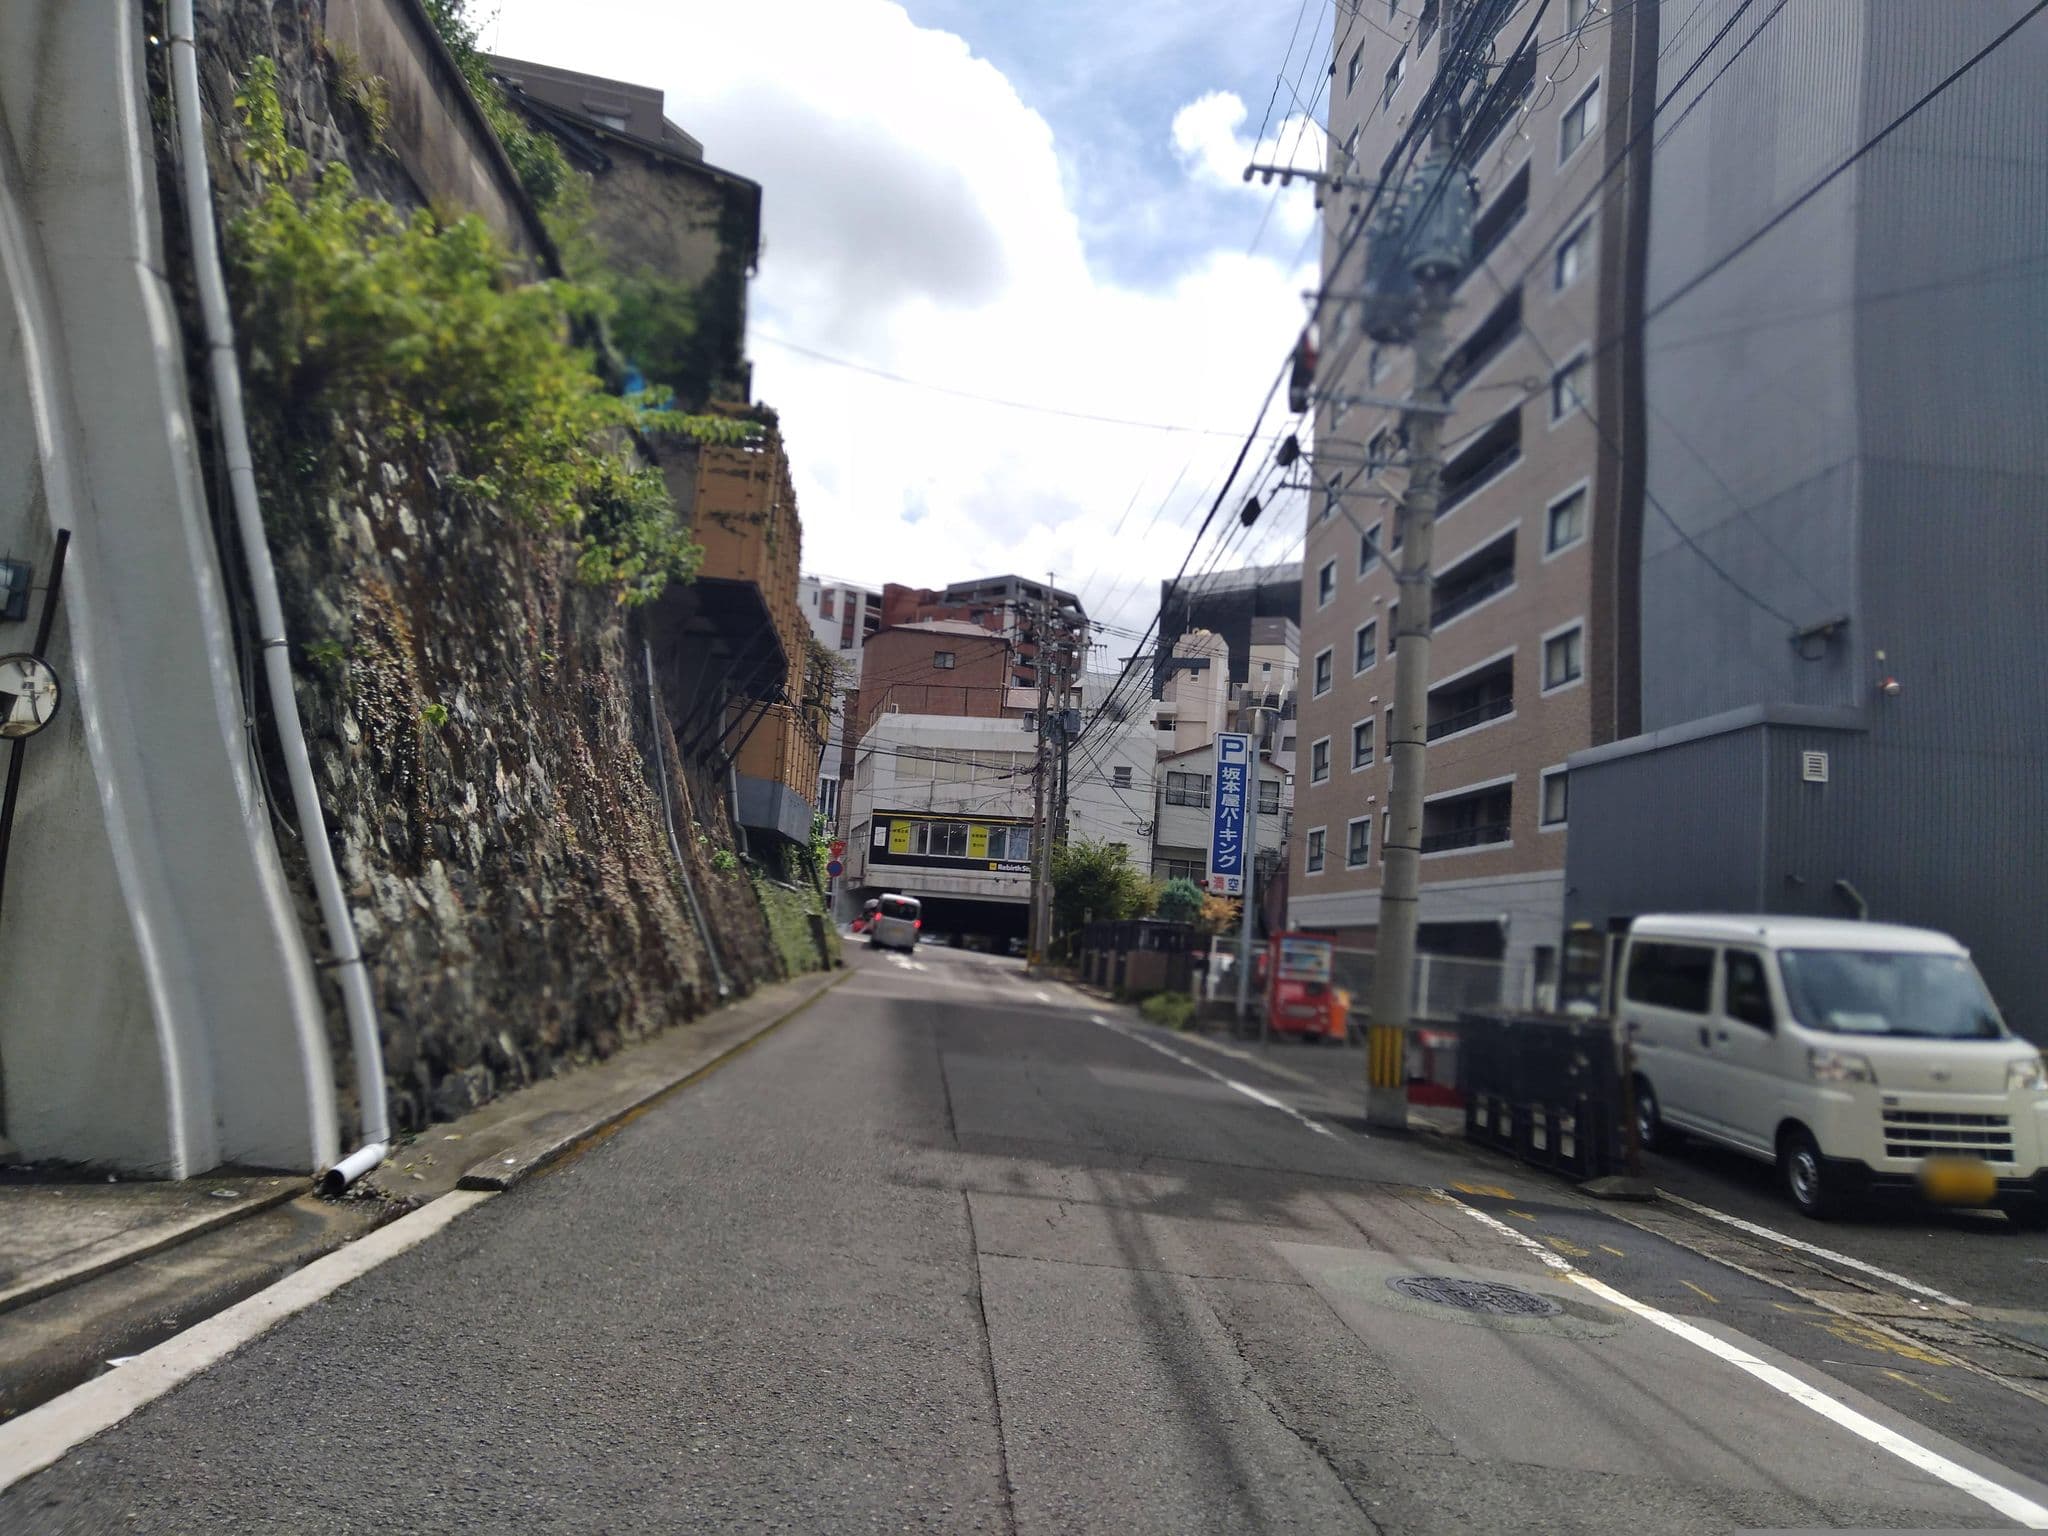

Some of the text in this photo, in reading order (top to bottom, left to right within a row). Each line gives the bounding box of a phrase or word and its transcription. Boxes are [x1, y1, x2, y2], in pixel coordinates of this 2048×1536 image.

[1222, 739, 1243, 760] P
[1218, 767, 1240, 868] 坂本屋パーキング
